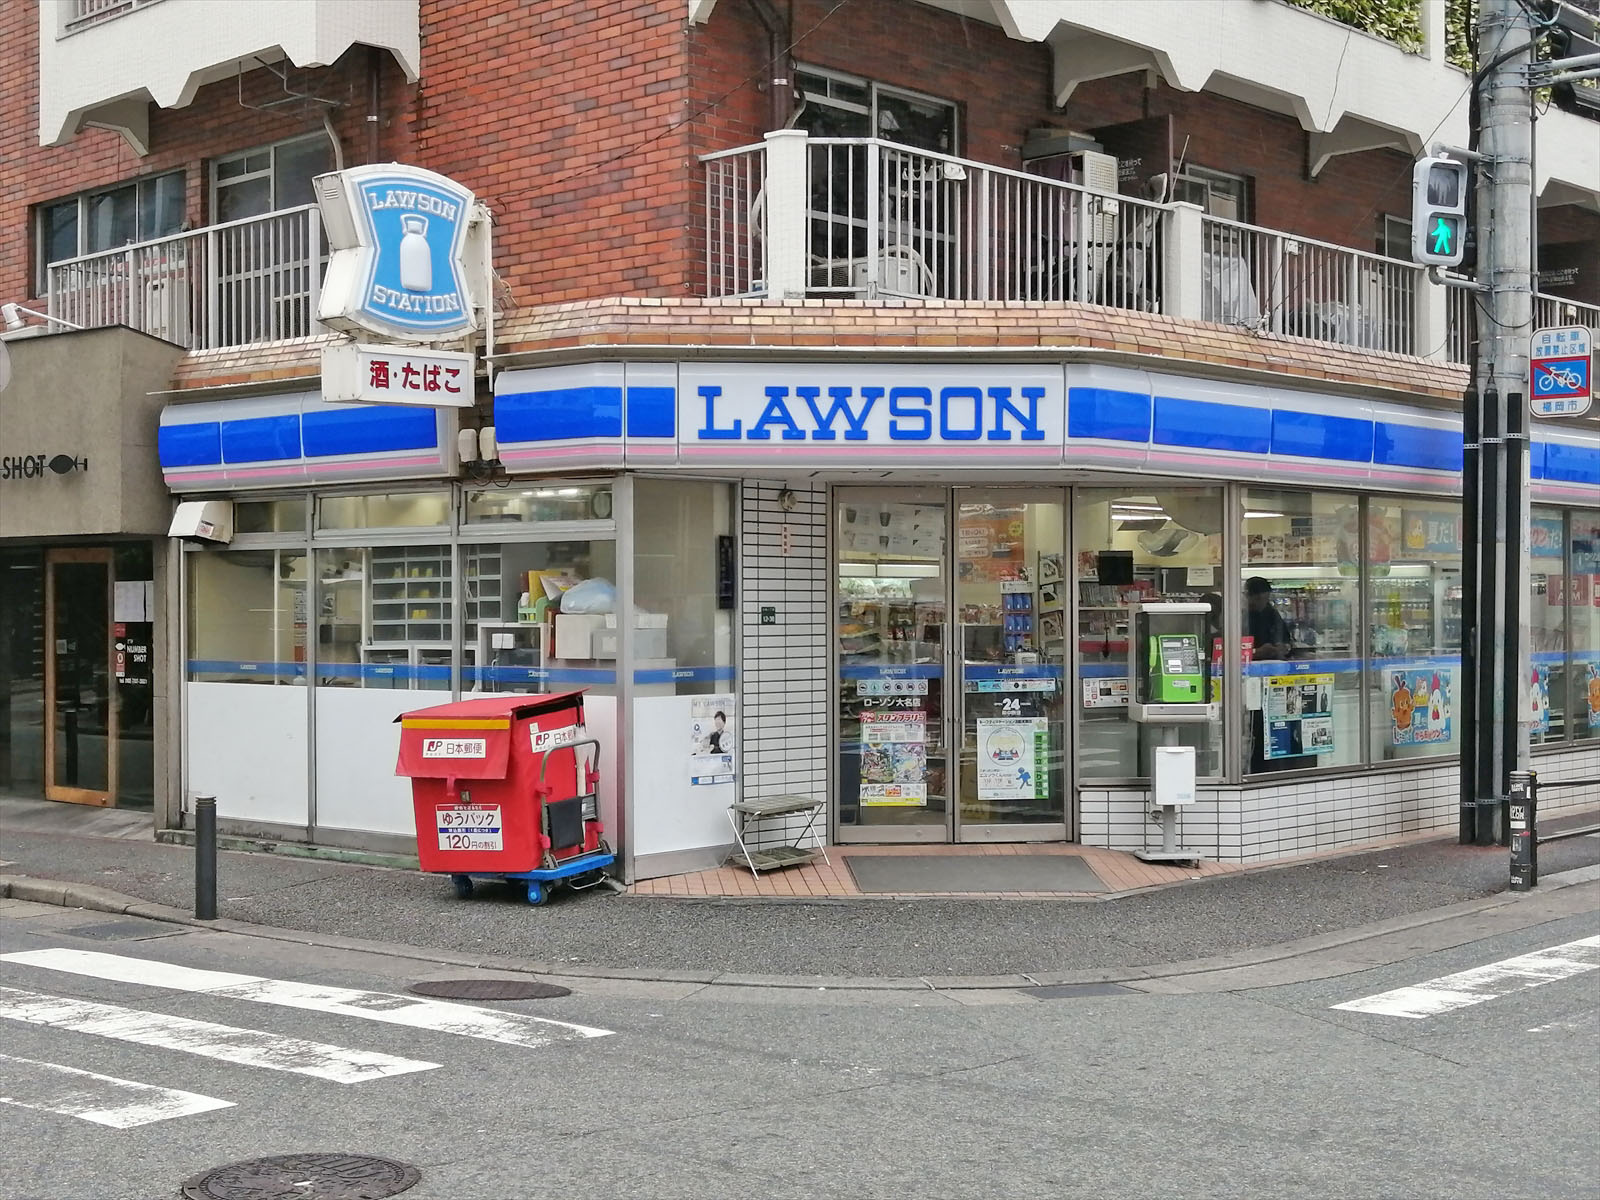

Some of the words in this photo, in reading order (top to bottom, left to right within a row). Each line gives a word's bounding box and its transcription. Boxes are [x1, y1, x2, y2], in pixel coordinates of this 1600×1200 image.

[369, 190, 457, 222] LAWSON
[373, 285, 460, 314] STATION
[370, 360, 461, 393] 酒・たばこ
[698, 386, 1046, 441] LAWSON
[2, 454, 46, 480] SHOT
[134, 654, 147, 662] SHOT
[864, 698, 920, 707] ローソン大名店
[1002, 698, 1021, 710] 24
[446, 743, 482, 754] 日本郵便
[442, 813, 494, 826] ゆうパック
